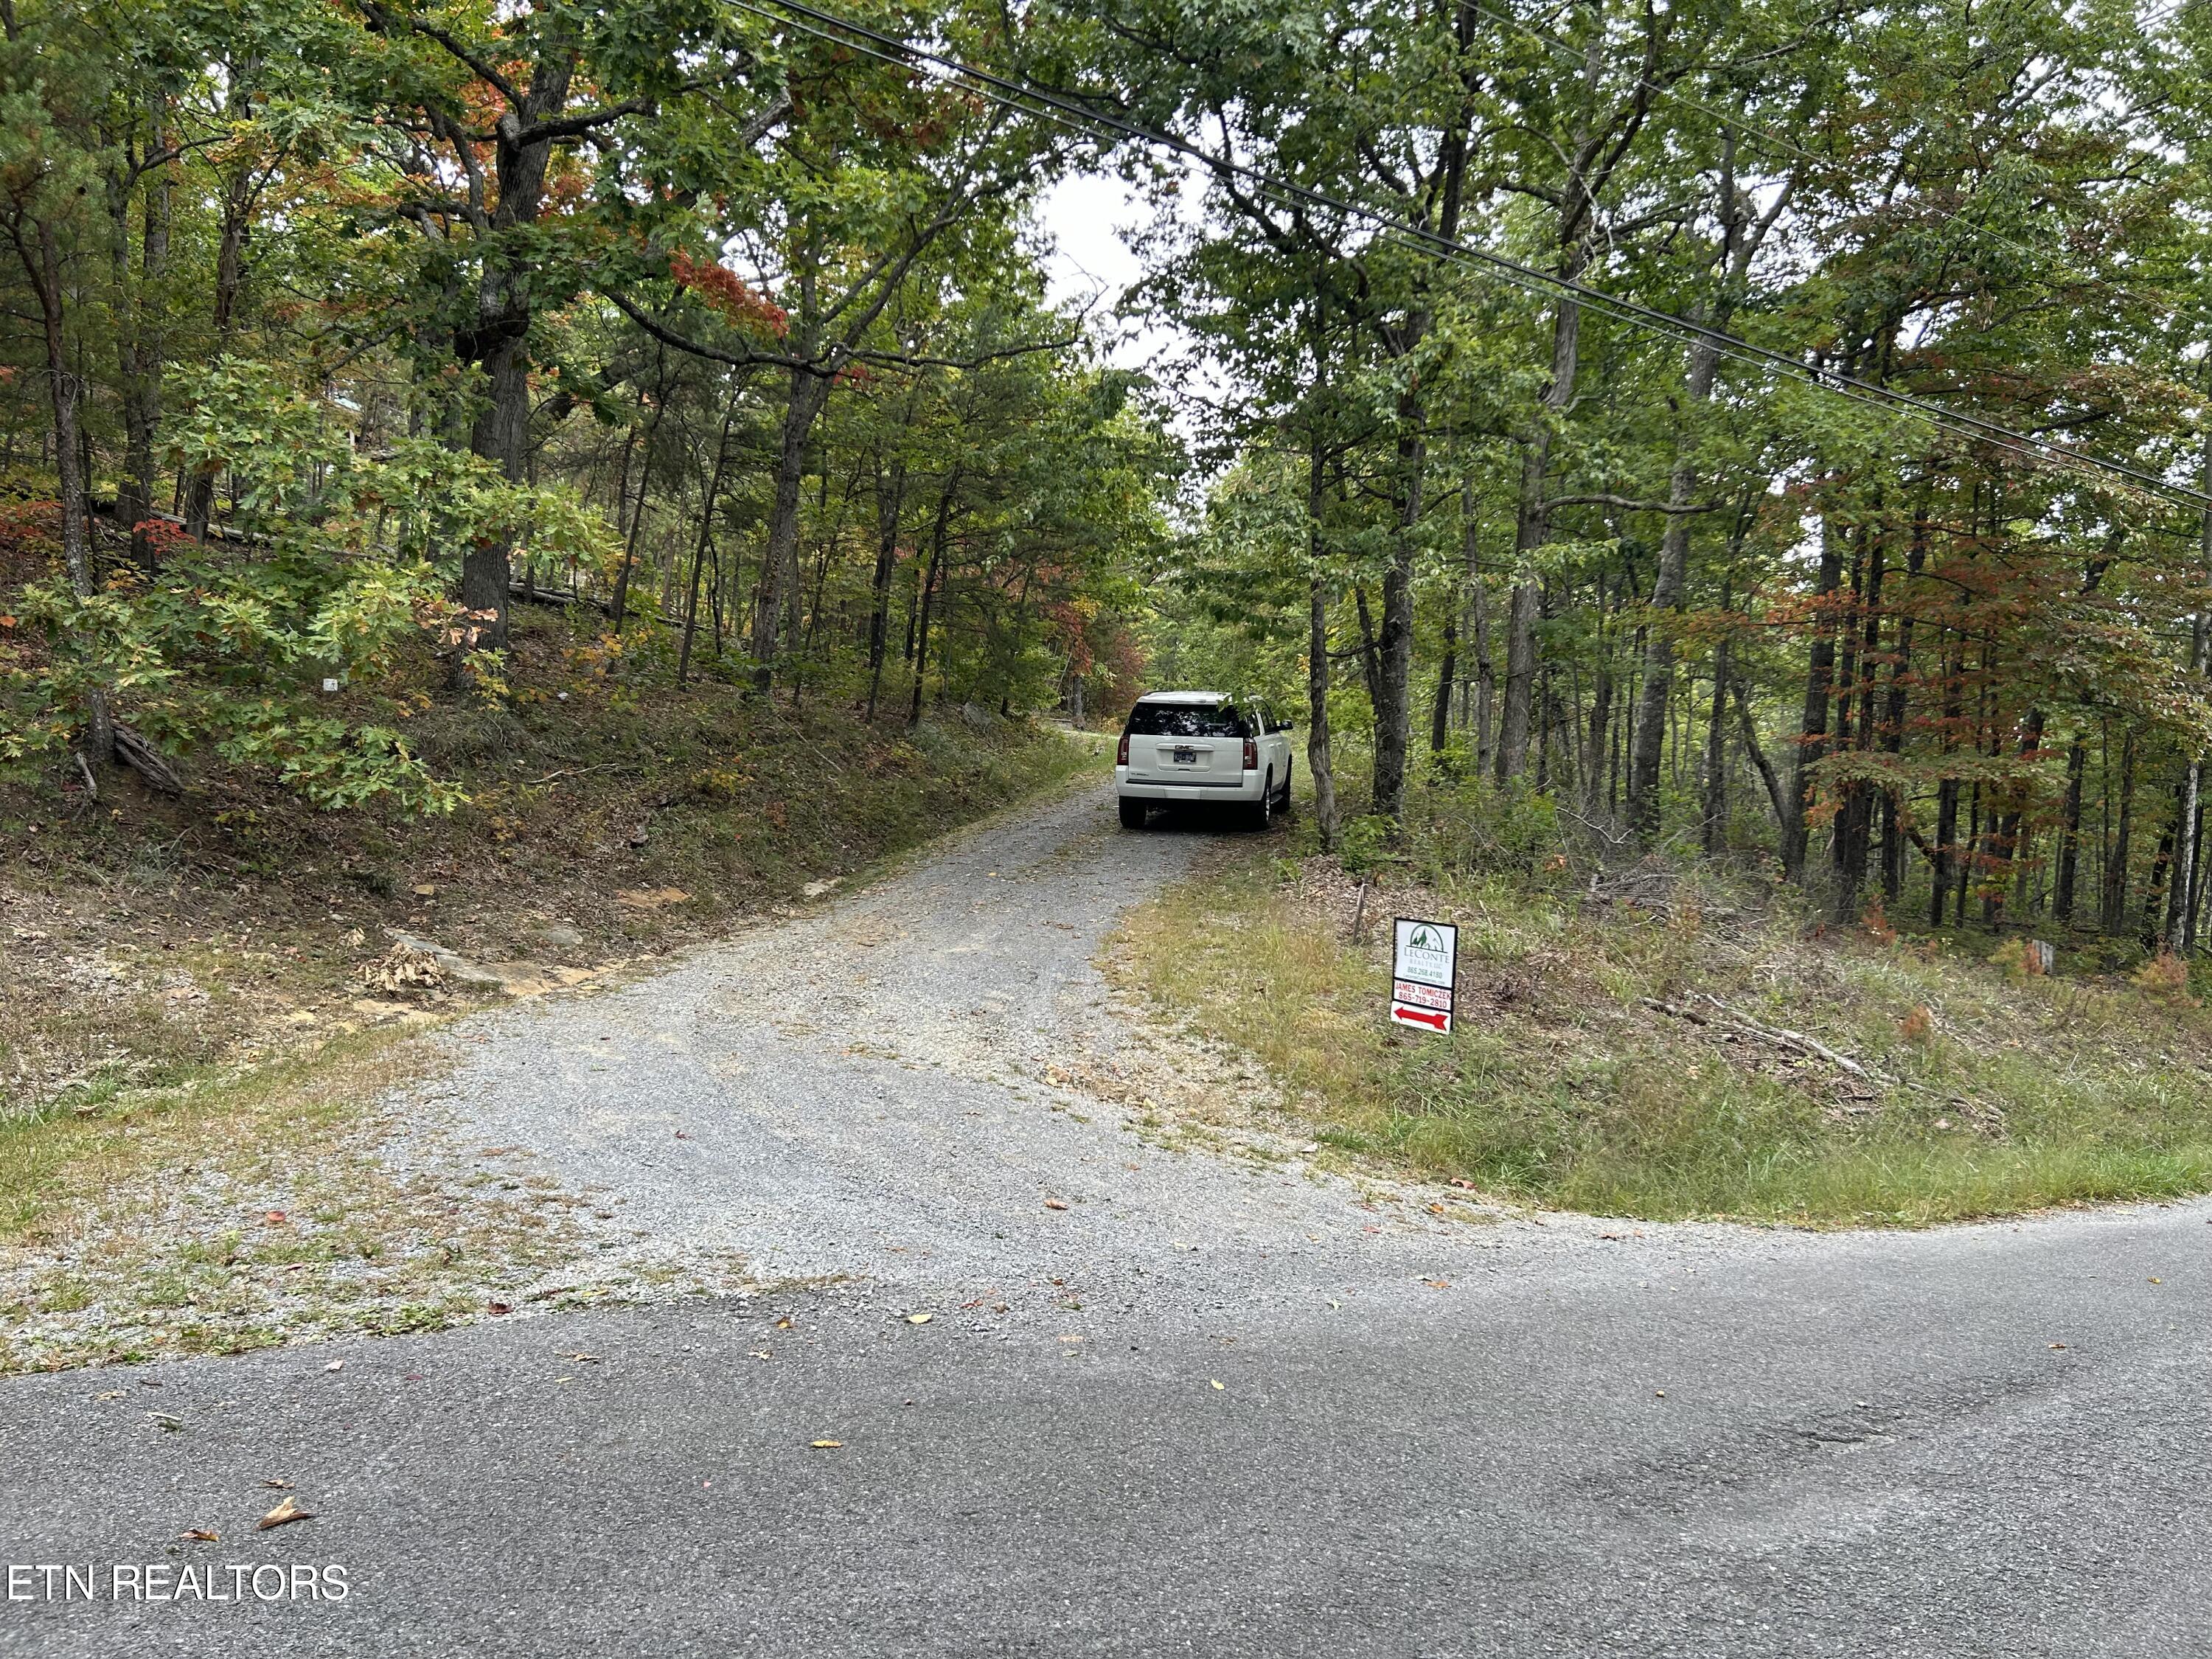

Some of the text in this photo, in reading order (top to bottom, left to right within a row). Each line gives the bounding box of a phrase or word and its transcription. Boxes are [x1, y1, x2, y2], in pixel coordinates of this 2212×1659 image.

[1395, 982, 1452, 1001] JAMES TOMICZEK
[1399, 992, 1447, 1009] 865-719-2810
